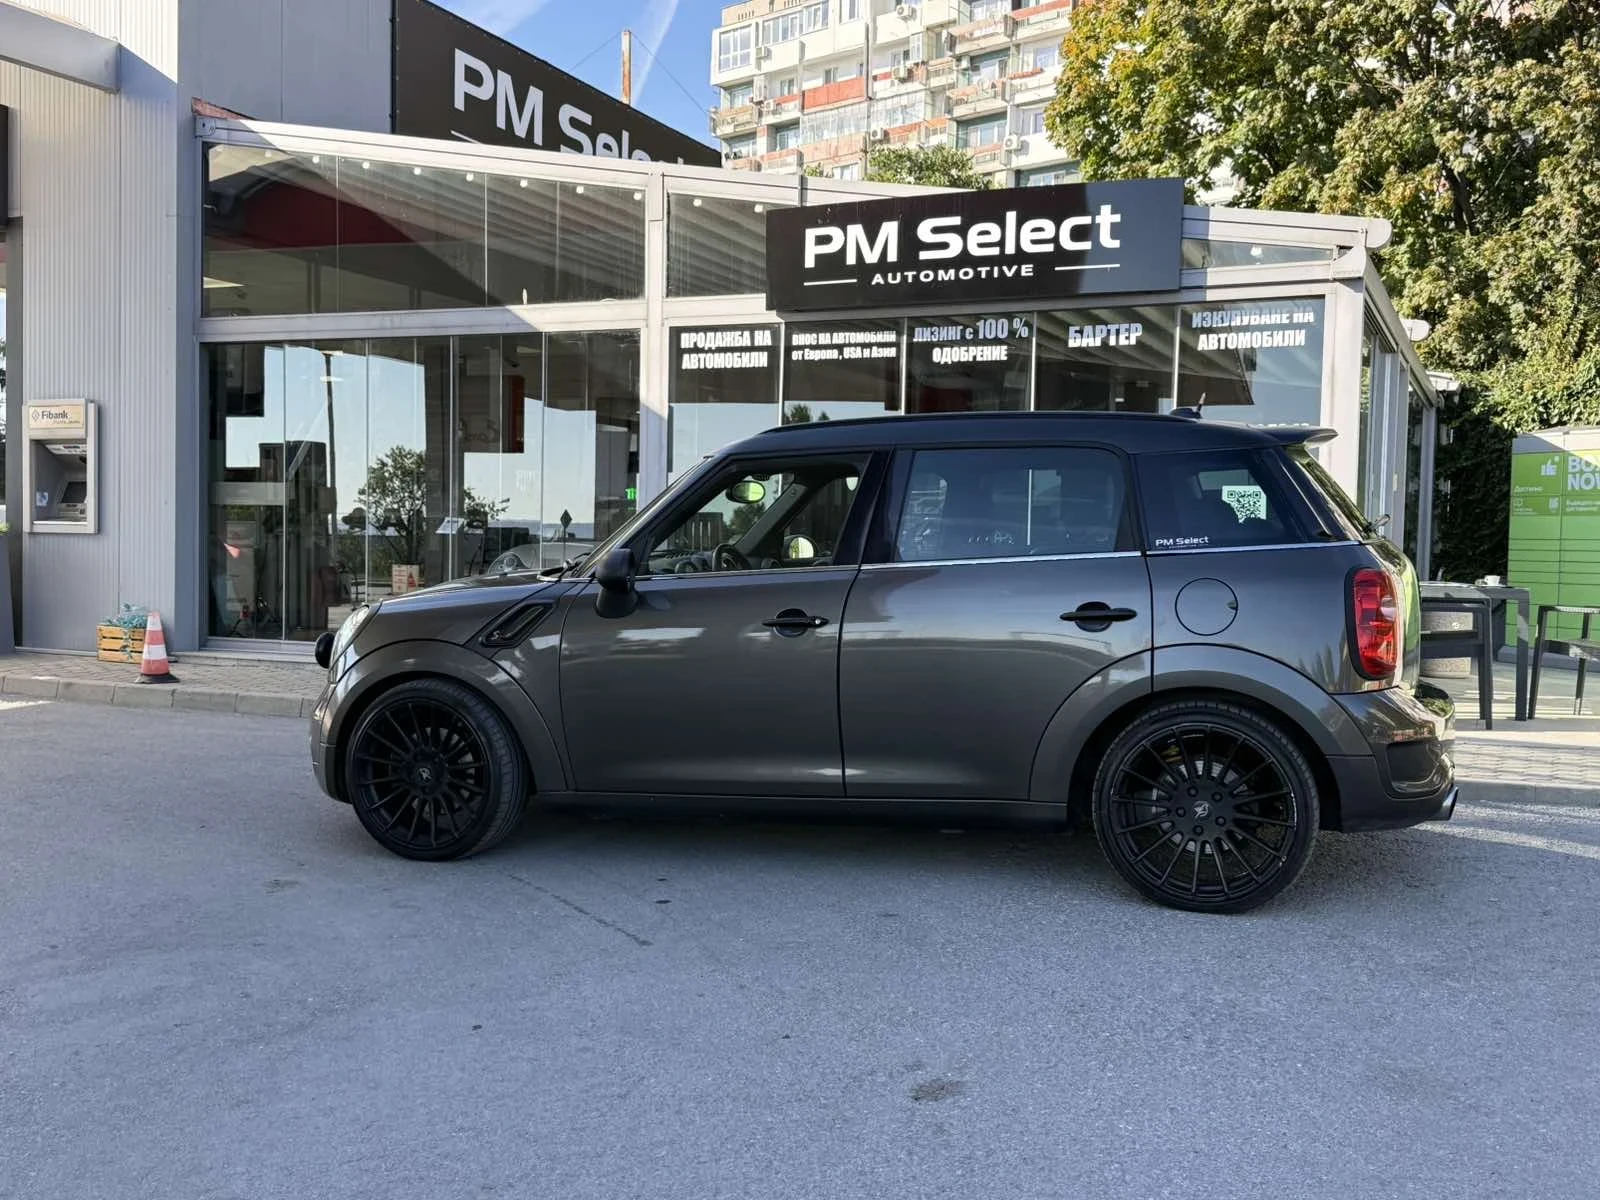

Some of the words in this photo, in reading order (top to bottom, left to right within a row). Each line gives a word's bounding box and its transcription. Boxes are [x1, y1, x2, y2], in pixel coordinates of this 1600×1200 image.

[454, 48, 544, 146] PM
[804, 220, 899, 269] PM
[916, 204, 1121, 260] Select
[871, 264, 1034, 286] AUTOMOTIVE
[680, 331, 751, 350] ПРОДАЖБА
[754, 329, 772, 346] НА
[818, 332, 831, 345] НА
[832, 331, 897, 344] АВТОМОБИЛИ
[912, 325, 964, 342] ЛИЗИНГ
[965, 327, 974, 340] с
[976, 318, 1009, 340] 100
[1012, 317, 1029, 339] %
[1068, 322, 1143, 348] БАРТЕР
[1197, 329, 1306, 351] АВТОМОБИЛИ
[681, 351, 768, 370] АВТОМОБИЛИ
[792, 350, 803, 360] от
[843, 346, 862, 359] USA
[871, 346, 897, 358] Азия
[932, 345, 1008, 365] ОДОБРЕНИЕ
[41, 410, 69, 420] Fibank
[1155, 538, 1174, 547] PM
[1175, 535, 1209, 545] Select
